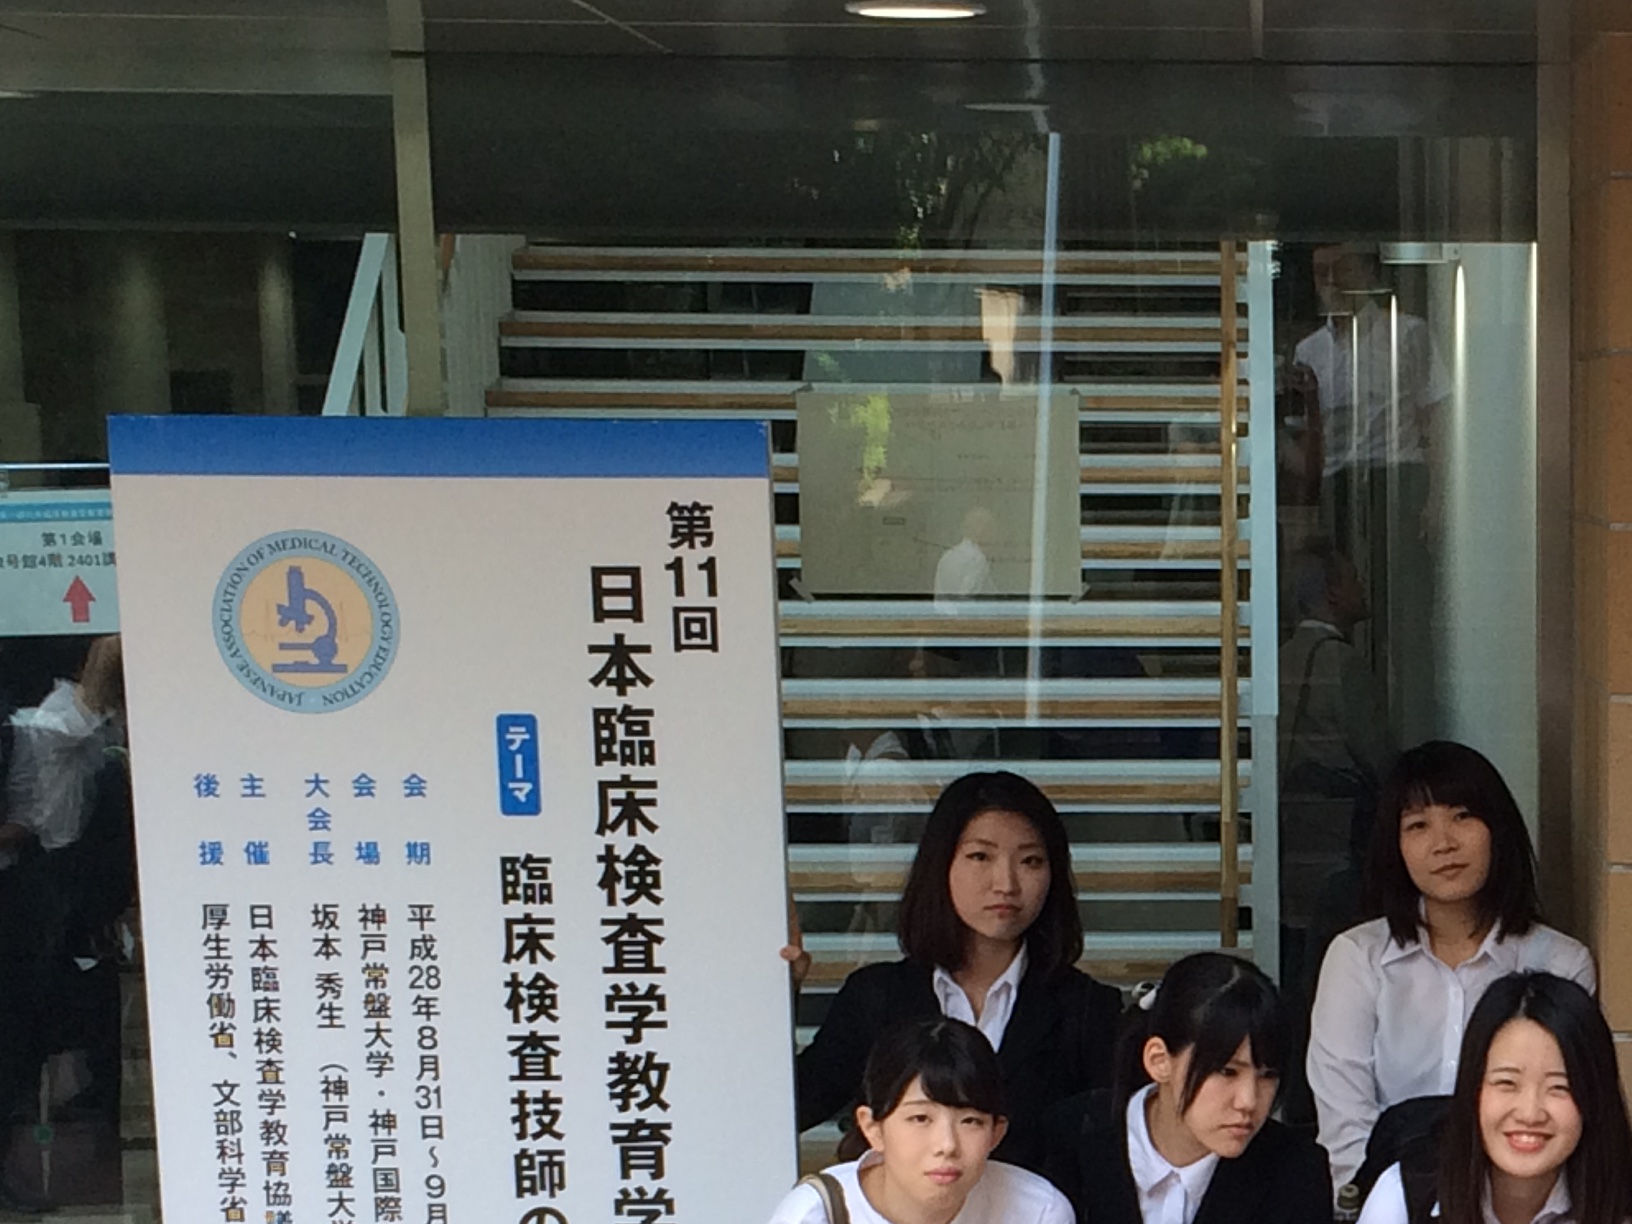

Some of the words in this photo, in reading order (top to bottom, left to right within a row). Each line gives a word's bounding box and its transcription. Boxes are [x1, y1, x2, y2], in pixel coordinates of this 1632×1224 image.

[0, 553, 63, 570] 号館4階
[246, 547, 267, 568] OF
[266, 537, 339, 556] MEDICAL
[664, 501, 720, 653] 第11回
[219, 561, 251, 660] ASSOCIATION
[341, 548, 394, 643] TECHNOLOGY
[235, 659, 305, 706] JAPANESE
[322, 646, 390, 706] EDUCATION
[505, 725, 533, 804] テーマ
[305, 773, 334, 865] 大会長
